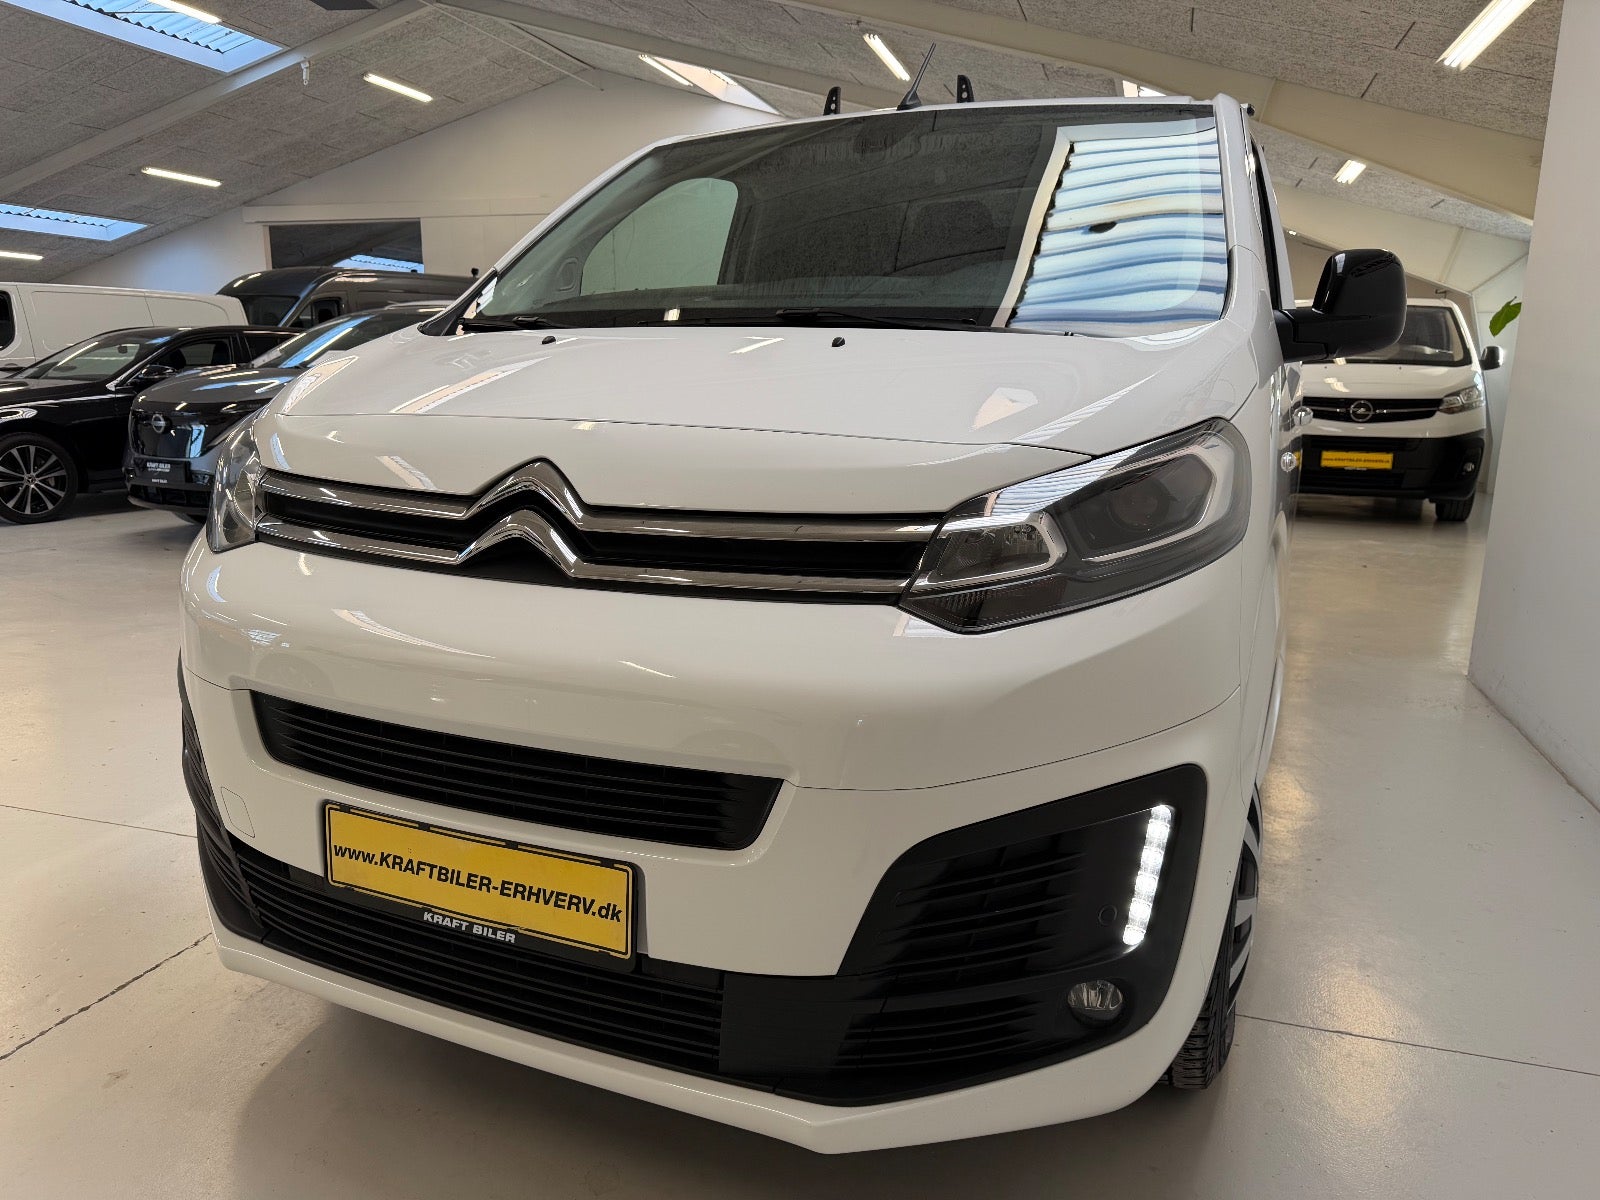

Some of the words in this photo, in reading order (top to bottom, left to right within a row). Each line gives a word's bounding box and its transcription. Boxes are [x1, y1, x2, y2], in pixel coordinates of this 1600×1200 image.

[333, 844, 622, 922] www.KRAFTBILER-ERHVERV.dk
[423, 911, 469, 931] KRAFT
[472, 924, 516, 943] BILER
